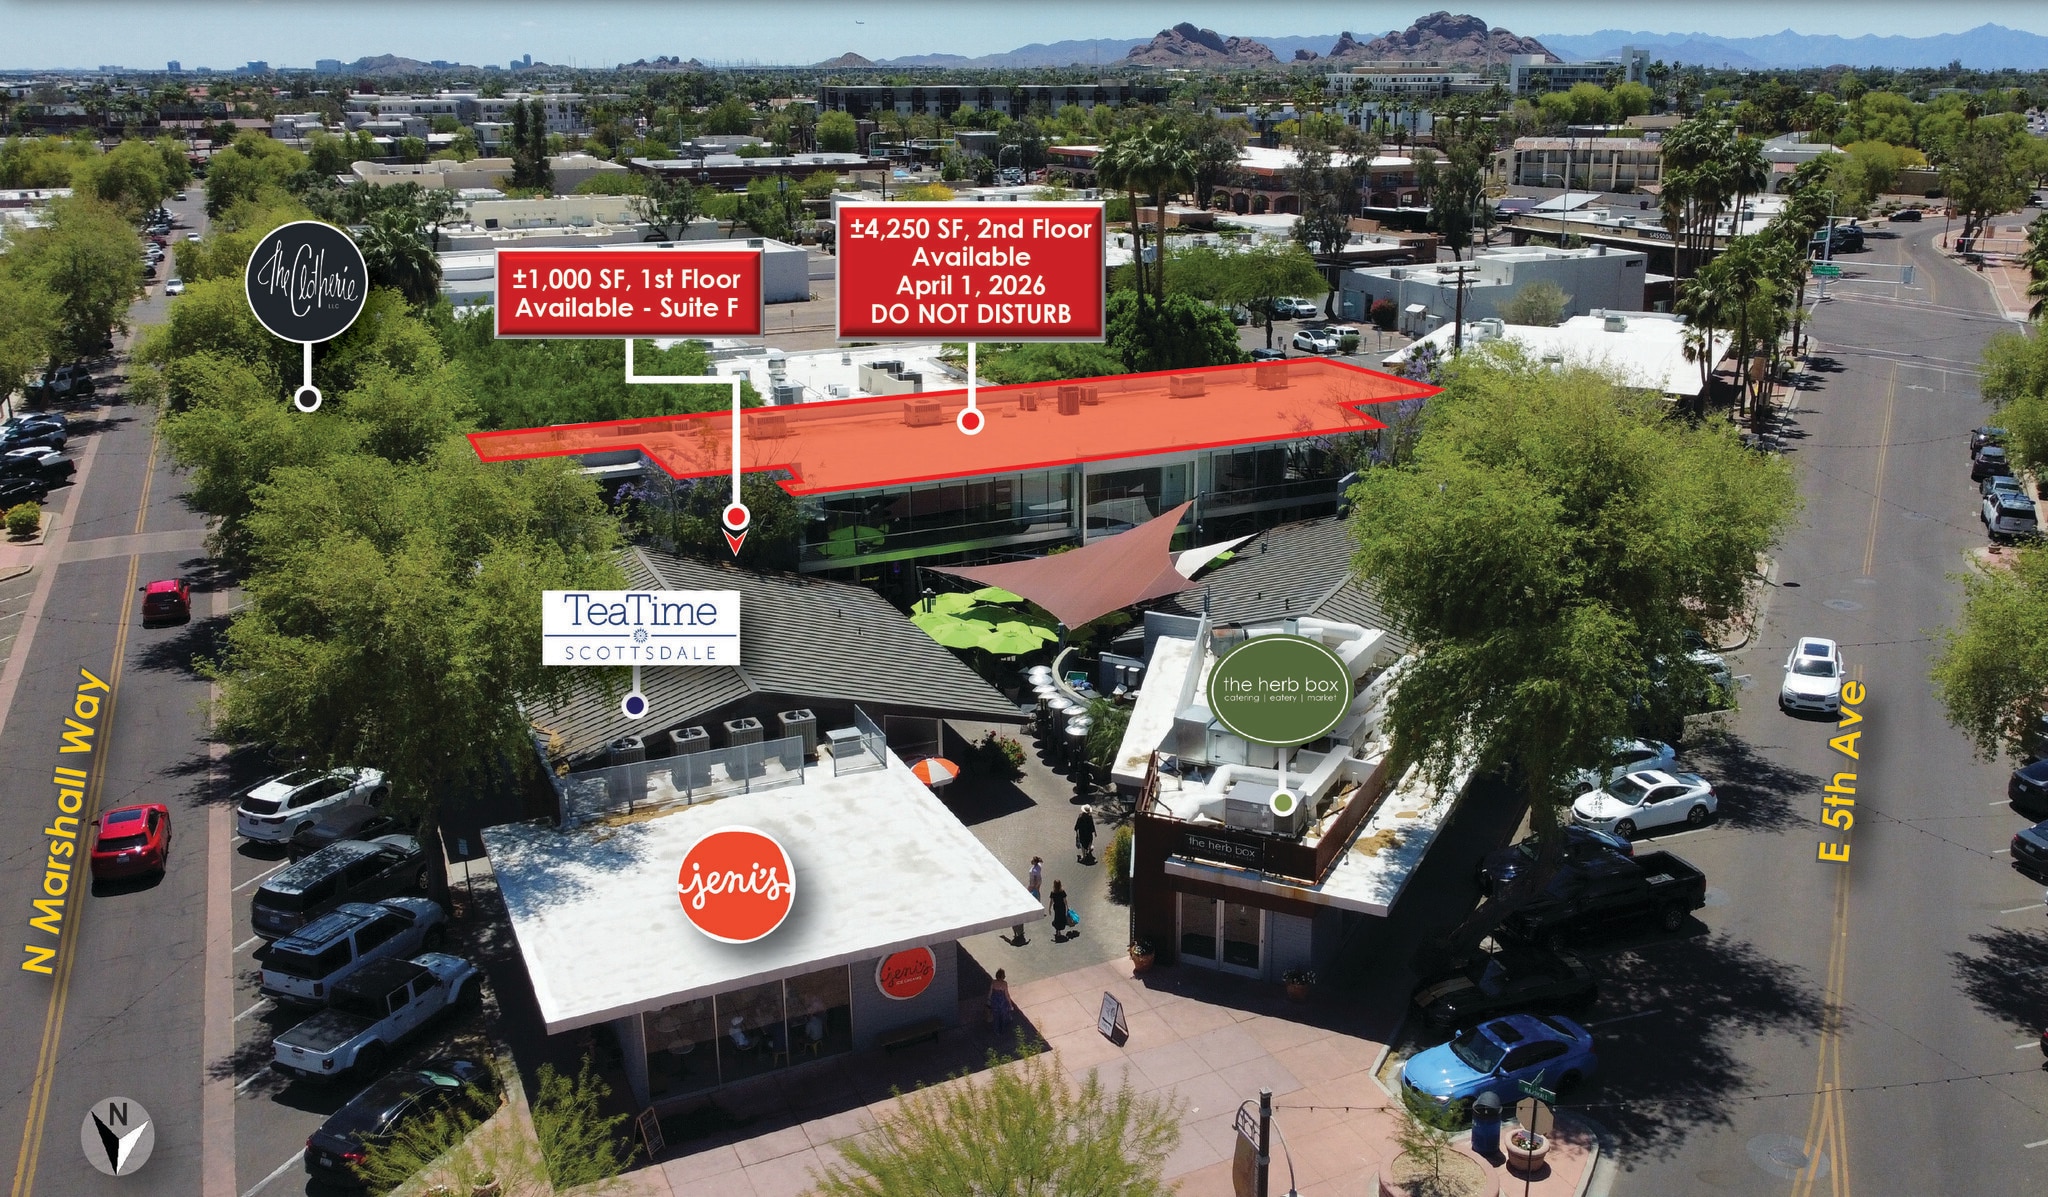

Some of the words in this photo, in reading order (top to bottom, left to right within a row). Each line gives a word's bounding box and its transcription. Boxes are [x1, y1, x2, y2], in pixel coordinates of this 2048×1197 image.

[1189, 836, 1205, 848] the
[1208, 841, 1233, 853] herb
[1235, 845, 1255, 858] box
